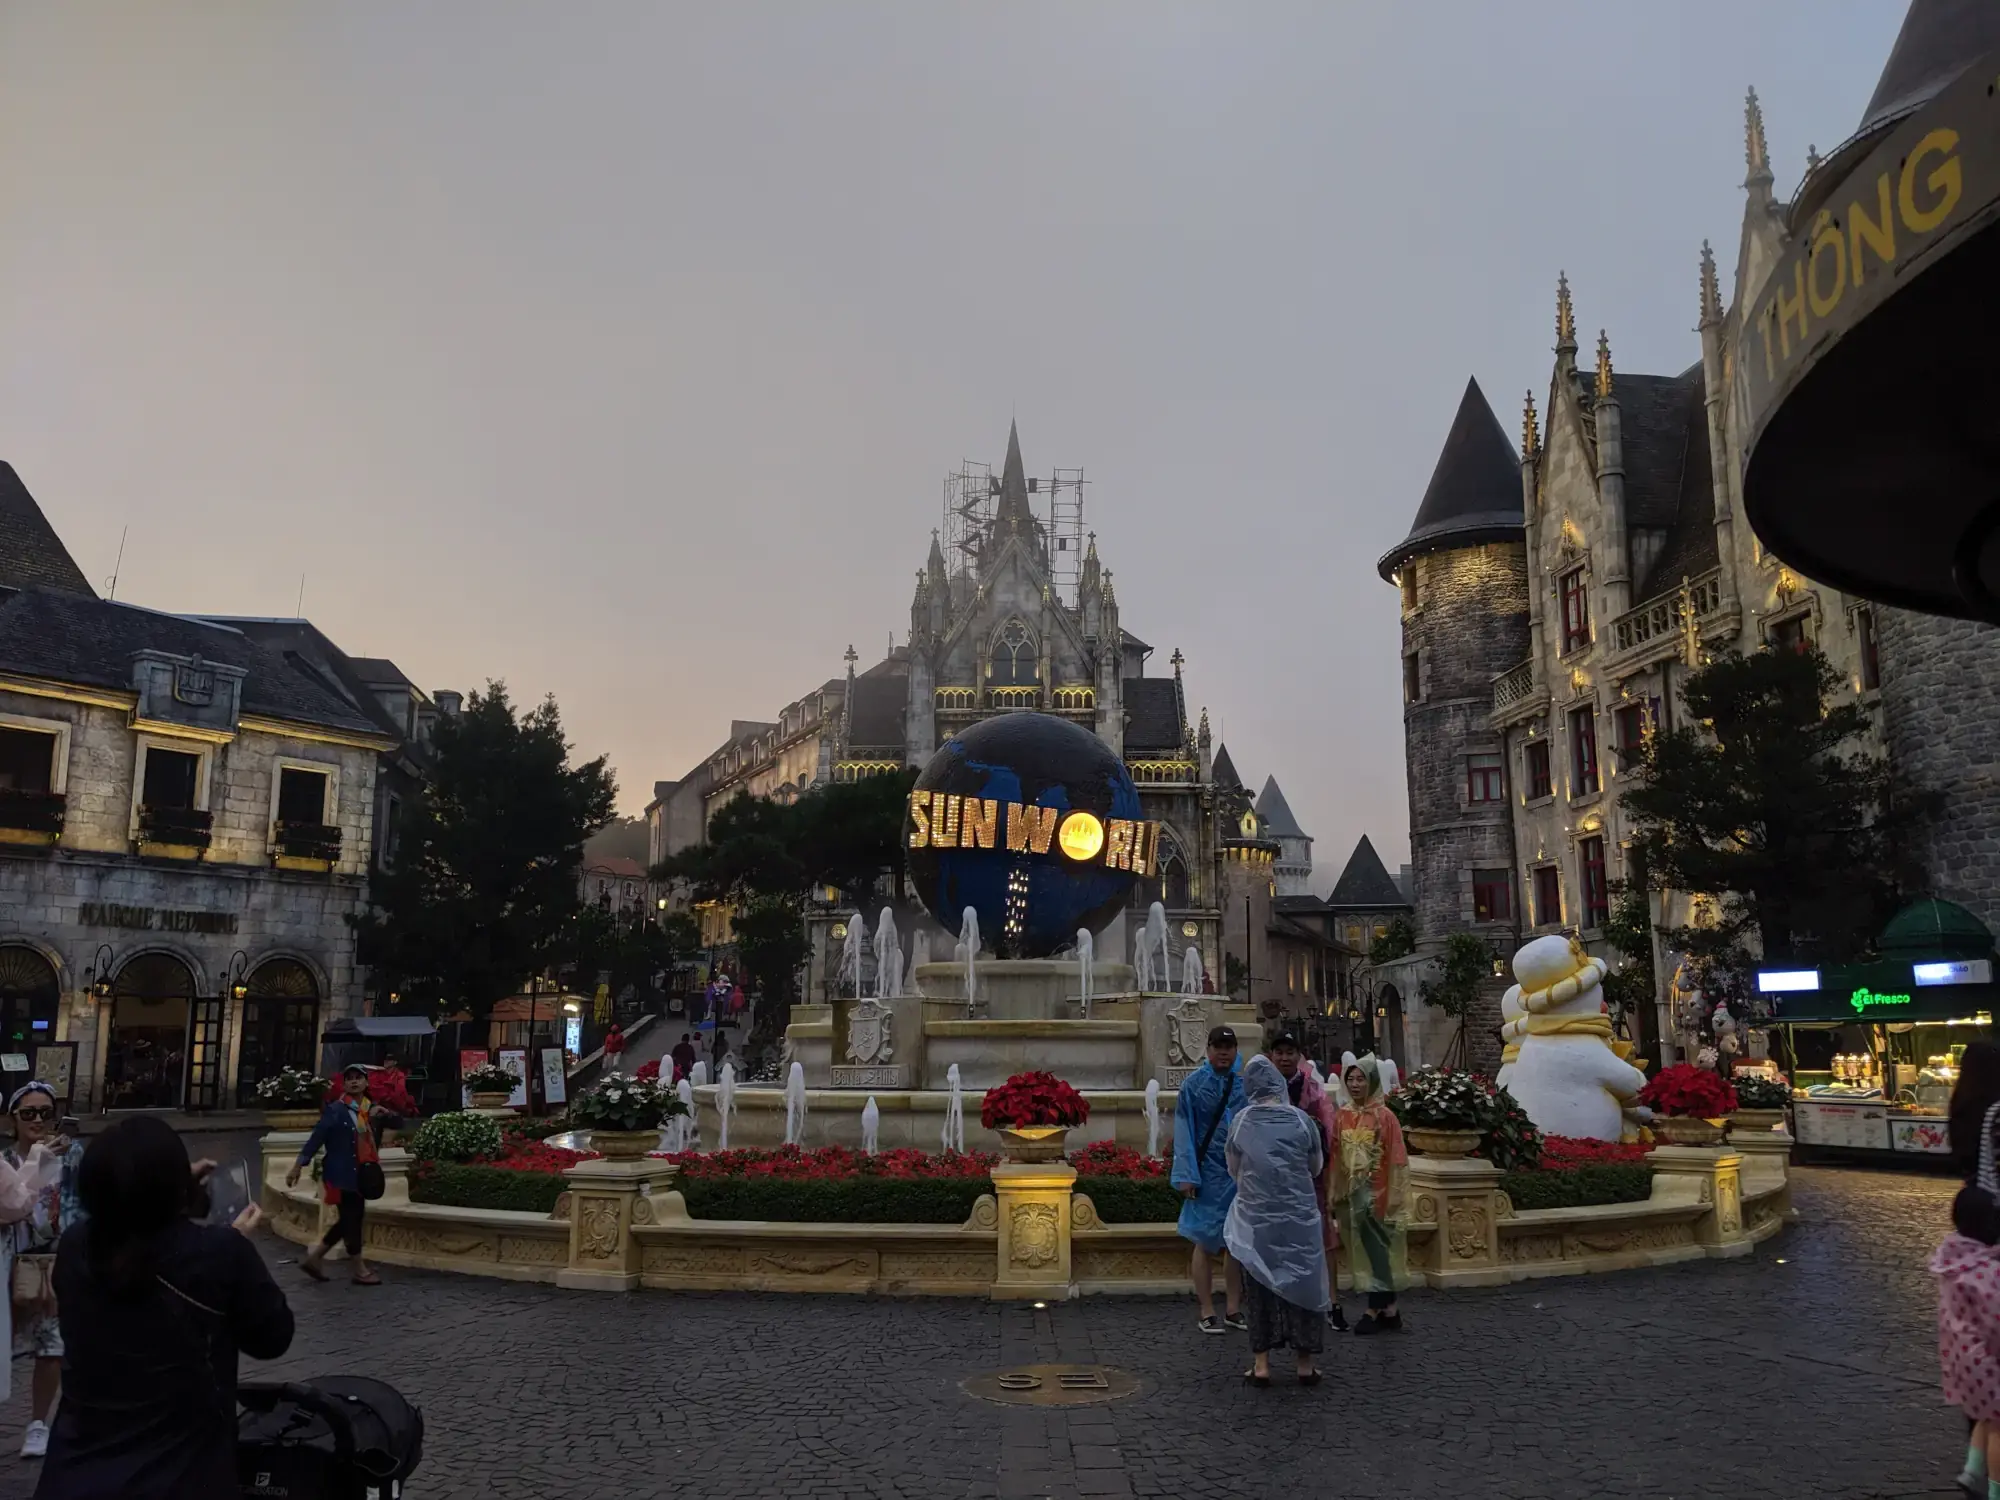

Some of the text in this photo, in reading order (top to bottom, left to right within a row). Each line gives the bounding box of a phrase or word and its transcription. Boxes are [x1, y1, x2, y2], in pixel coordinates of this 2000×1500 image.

[908, 789, 1160, 877] SUN WORLD
[1863, 993, 1911, 1005] El Fresco
